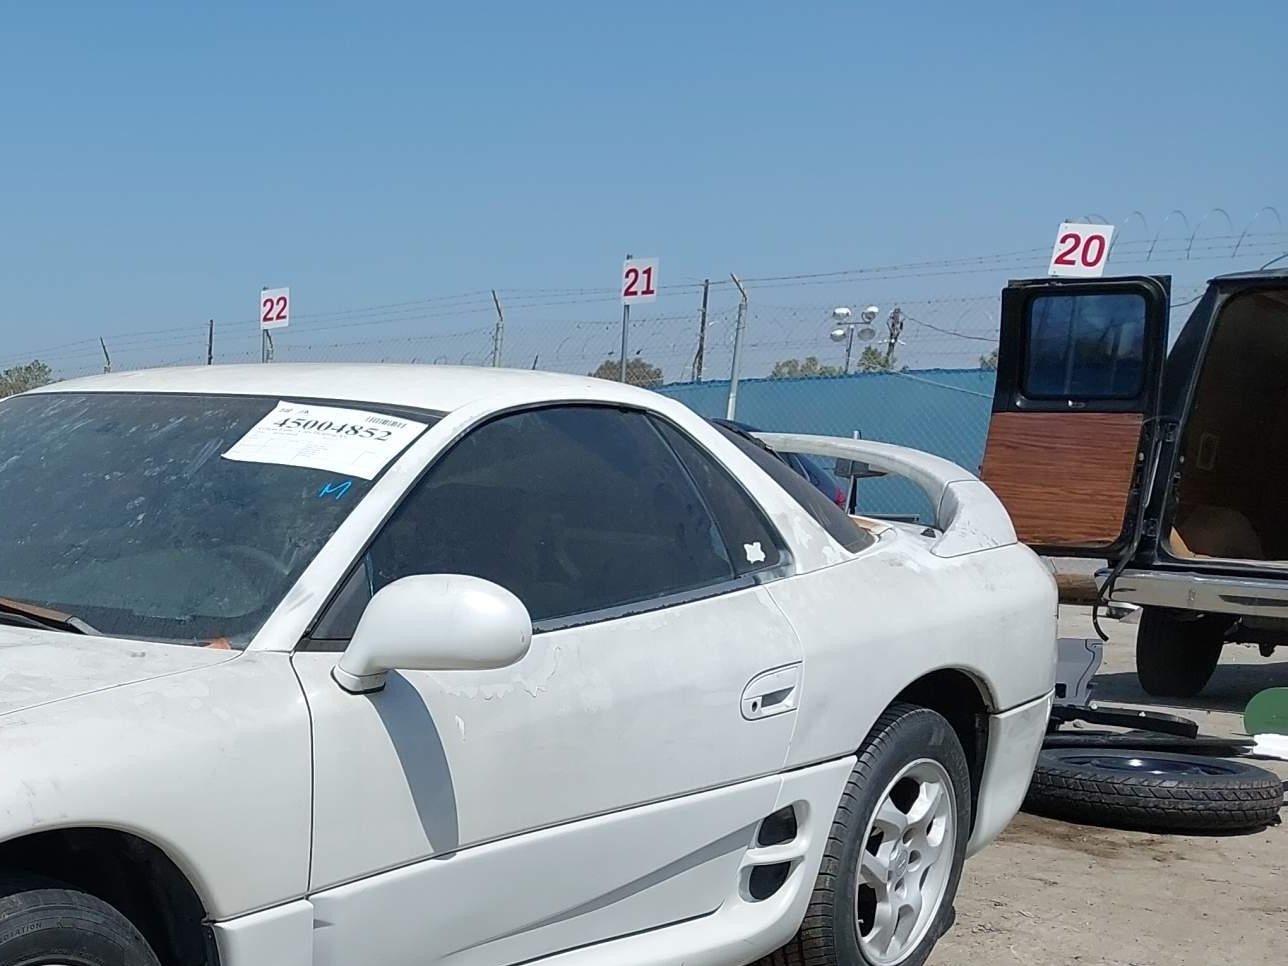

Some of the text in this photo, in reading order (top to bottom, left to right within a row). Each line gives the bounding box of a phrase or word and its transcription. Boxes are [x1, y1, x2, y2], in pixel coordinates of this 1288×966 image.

[1054, 233, 1106, 268] 20
[623, 266, 655, 298] 21
[262, 296, 288, 322] 22
[273, 417, 392, 442] 45004852
